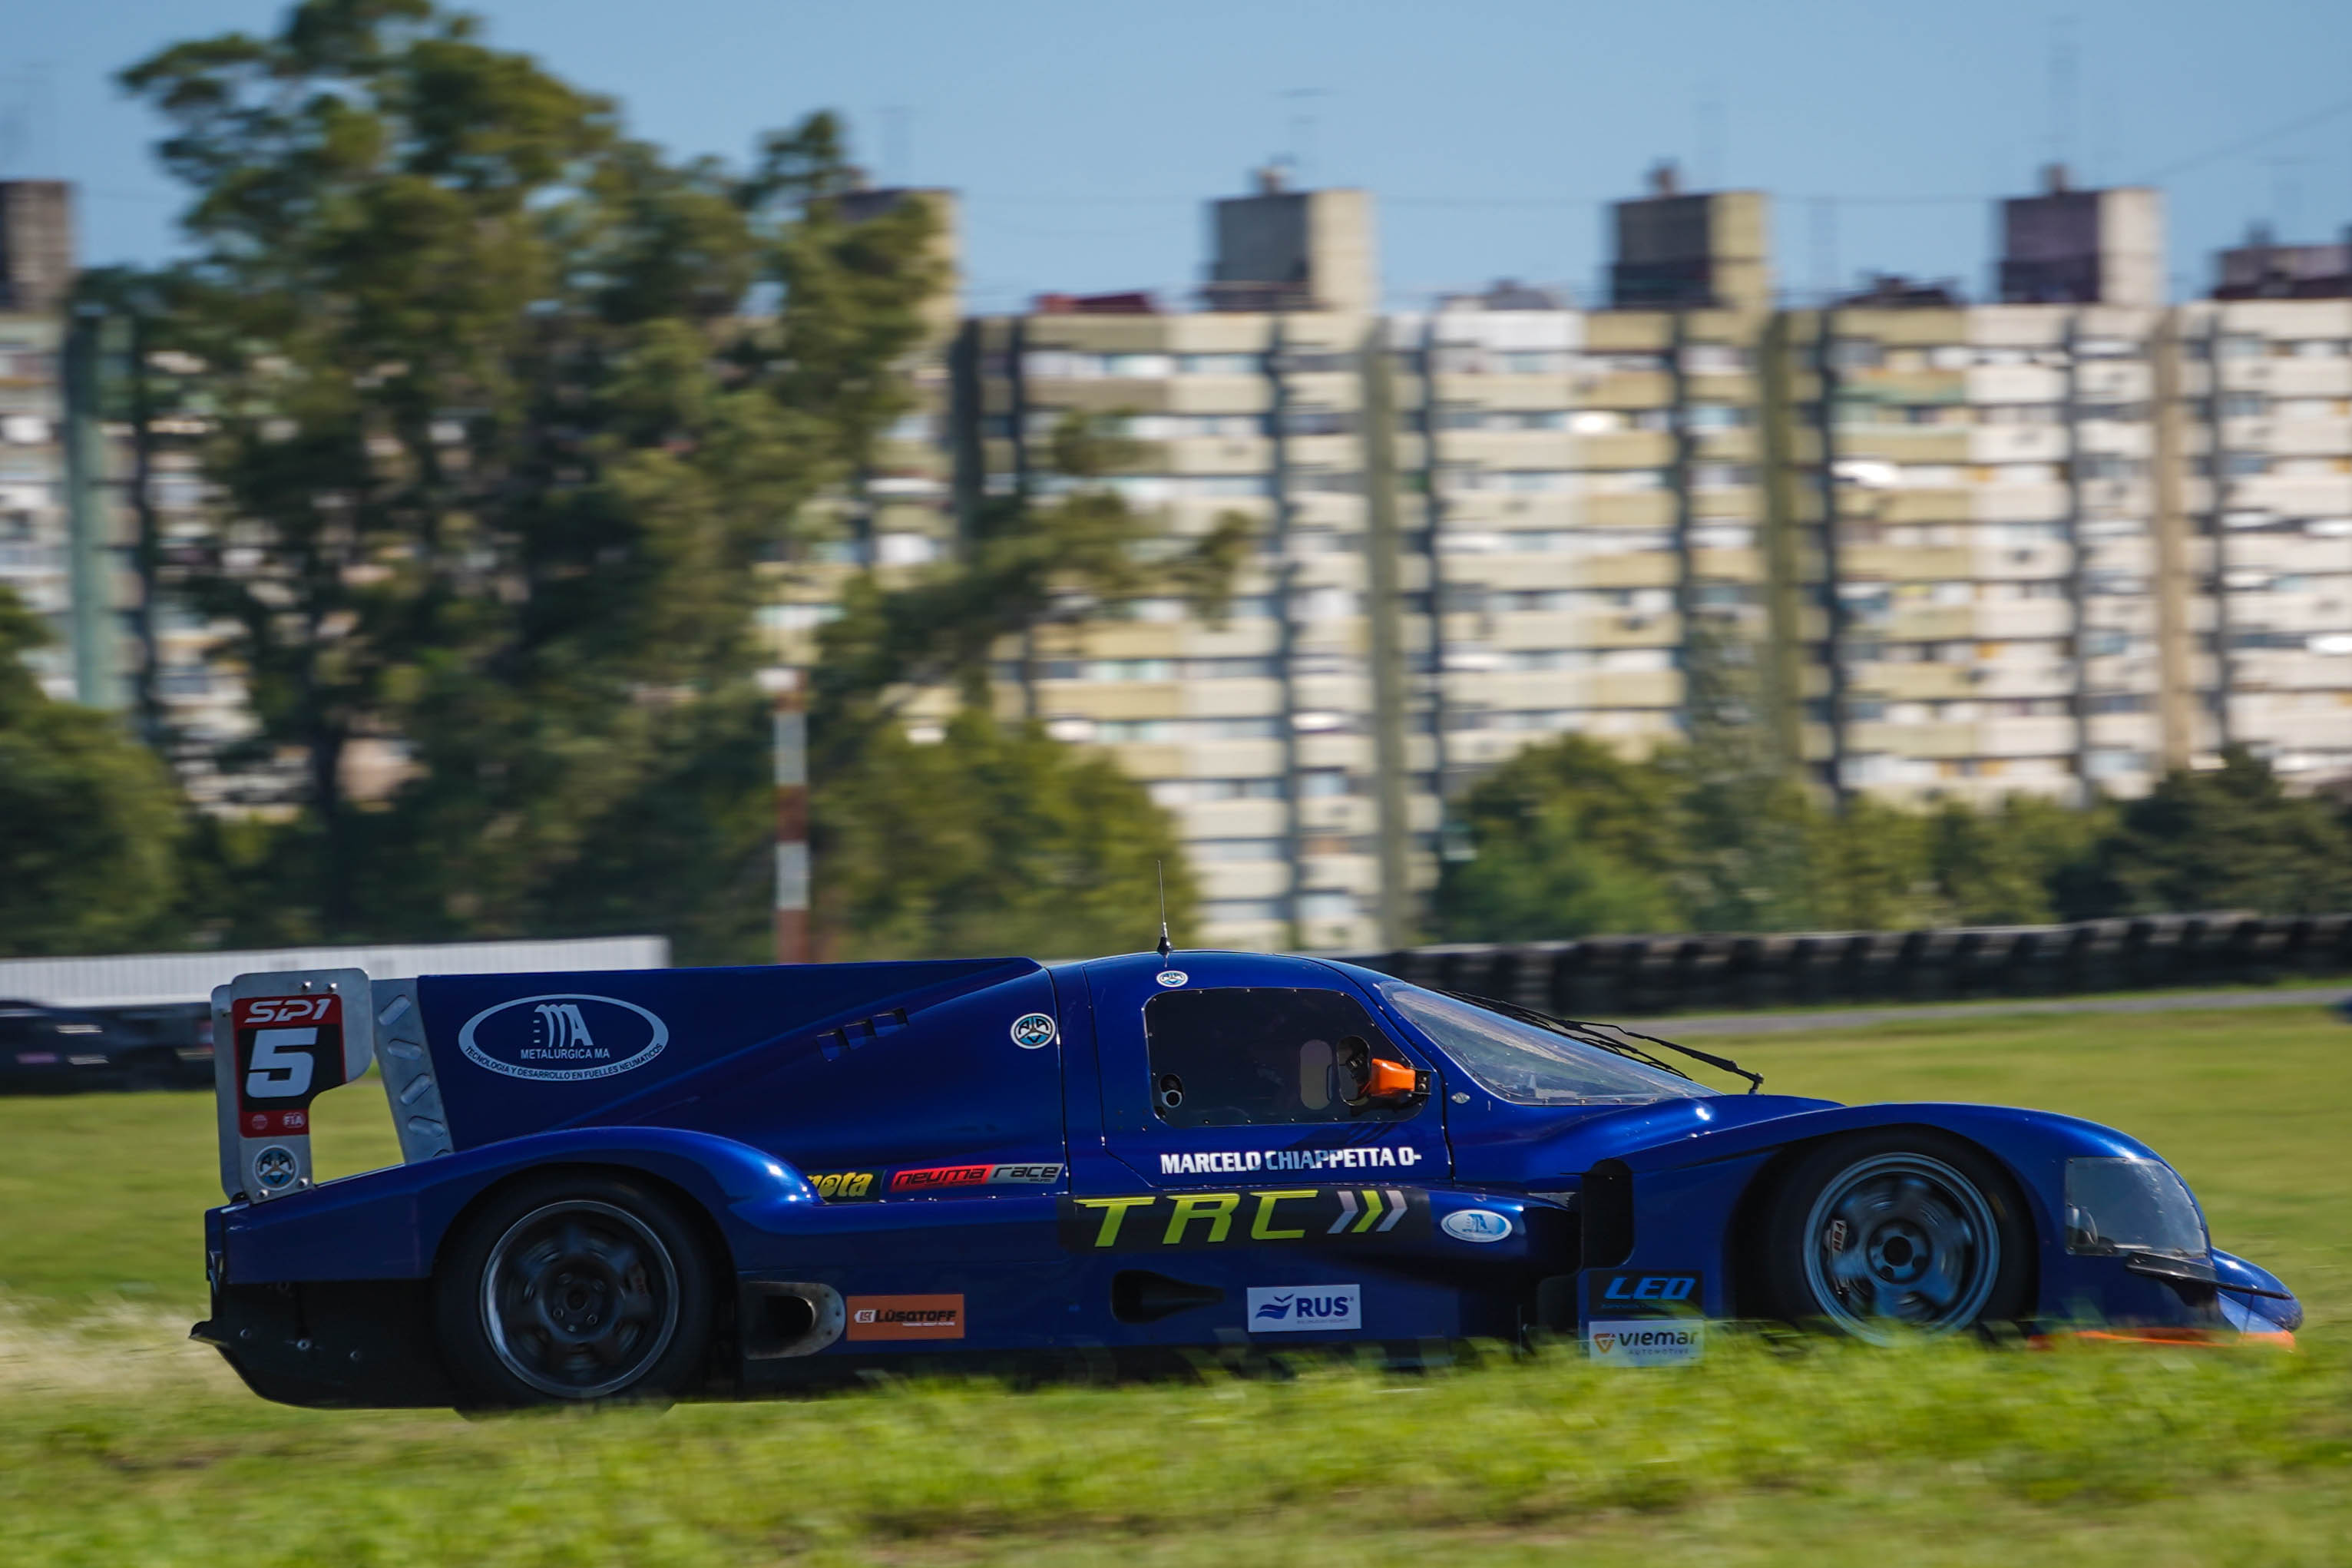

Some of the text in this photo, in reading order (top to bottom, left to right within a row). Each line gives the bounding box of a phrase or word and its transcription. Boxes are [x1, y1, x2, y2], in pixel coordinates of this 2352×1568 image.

[244, 998, 331, 1024] SP1
[245, 1027, 318, 1098] 5
[465, 1046, 510, 1073] TECNOLOGIA
[518, 1068, 571, 1080] DESARROLLO
[584, 1067, 619, 1078] FUELLES
[619, 1043, 663, 1070] NEUMATICOS
[521, 1048, 610, 1059] METALURGICA MA
[283, 1114, 303, 1126] FIA
[1160, 1152, 1262, 1174] MARCELO
[1265, 1147, 1396, 1170] CHIAPPETTA
[893, 1166, 987, 1186] neuma
[993, 1166, 1059, 1178] race
[1073, 1189, 1318, 1247] TRC
[1604, 1277, 1696, 1300] LED
[1295, 1296, 1349, 1318] RUS
